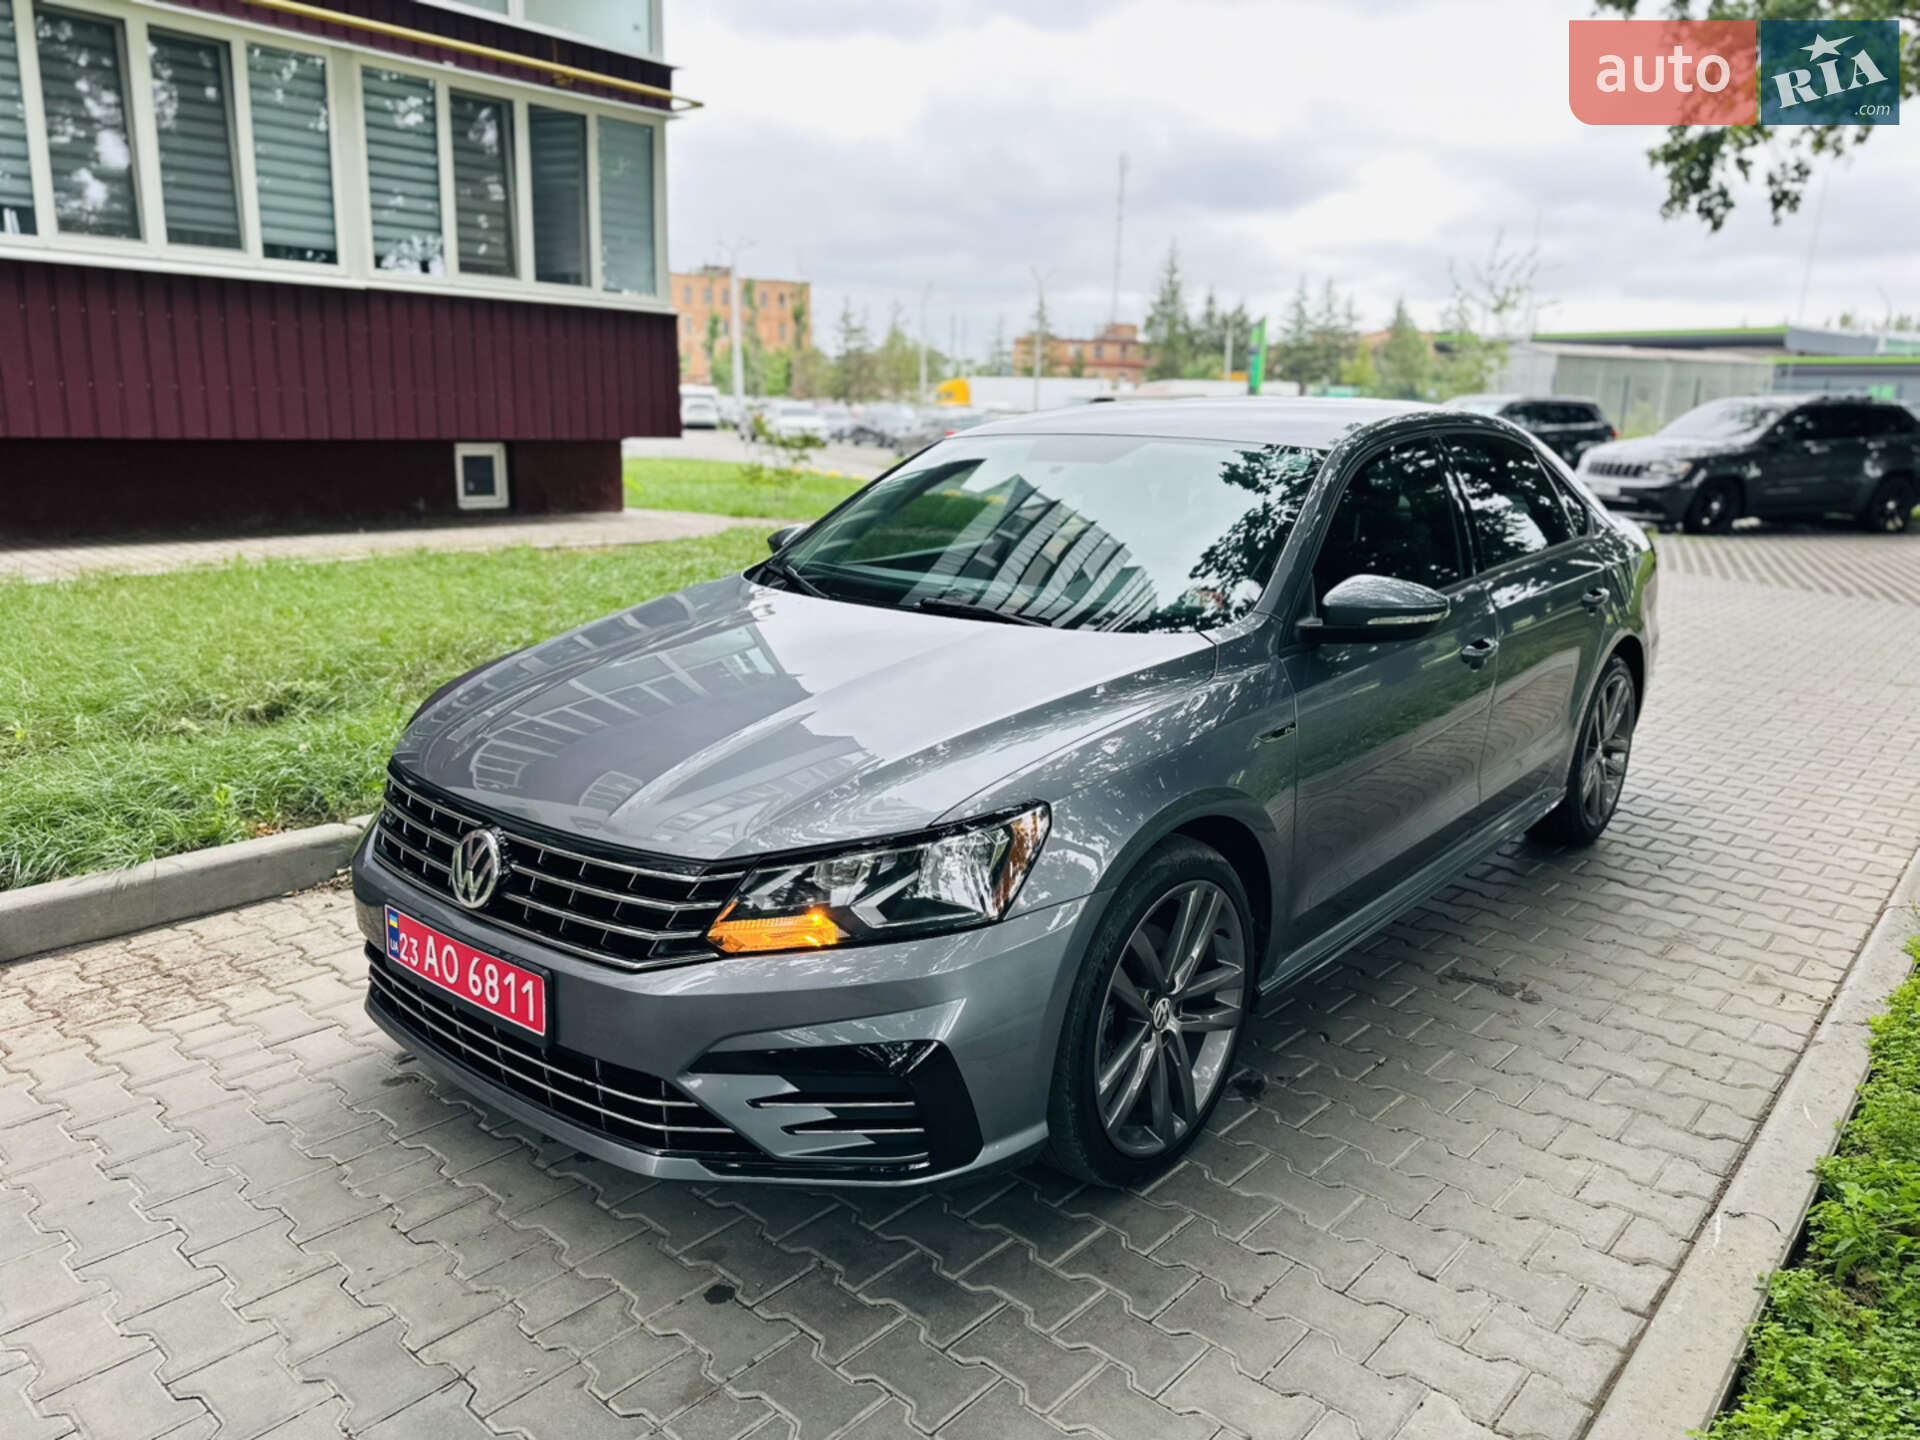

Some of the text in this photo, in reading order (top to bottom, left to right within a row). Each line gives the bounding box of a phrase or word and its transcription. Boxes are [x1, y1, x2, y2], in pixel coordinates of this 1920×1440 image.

[399, 932, 535, 1022] 23 AO 6811
